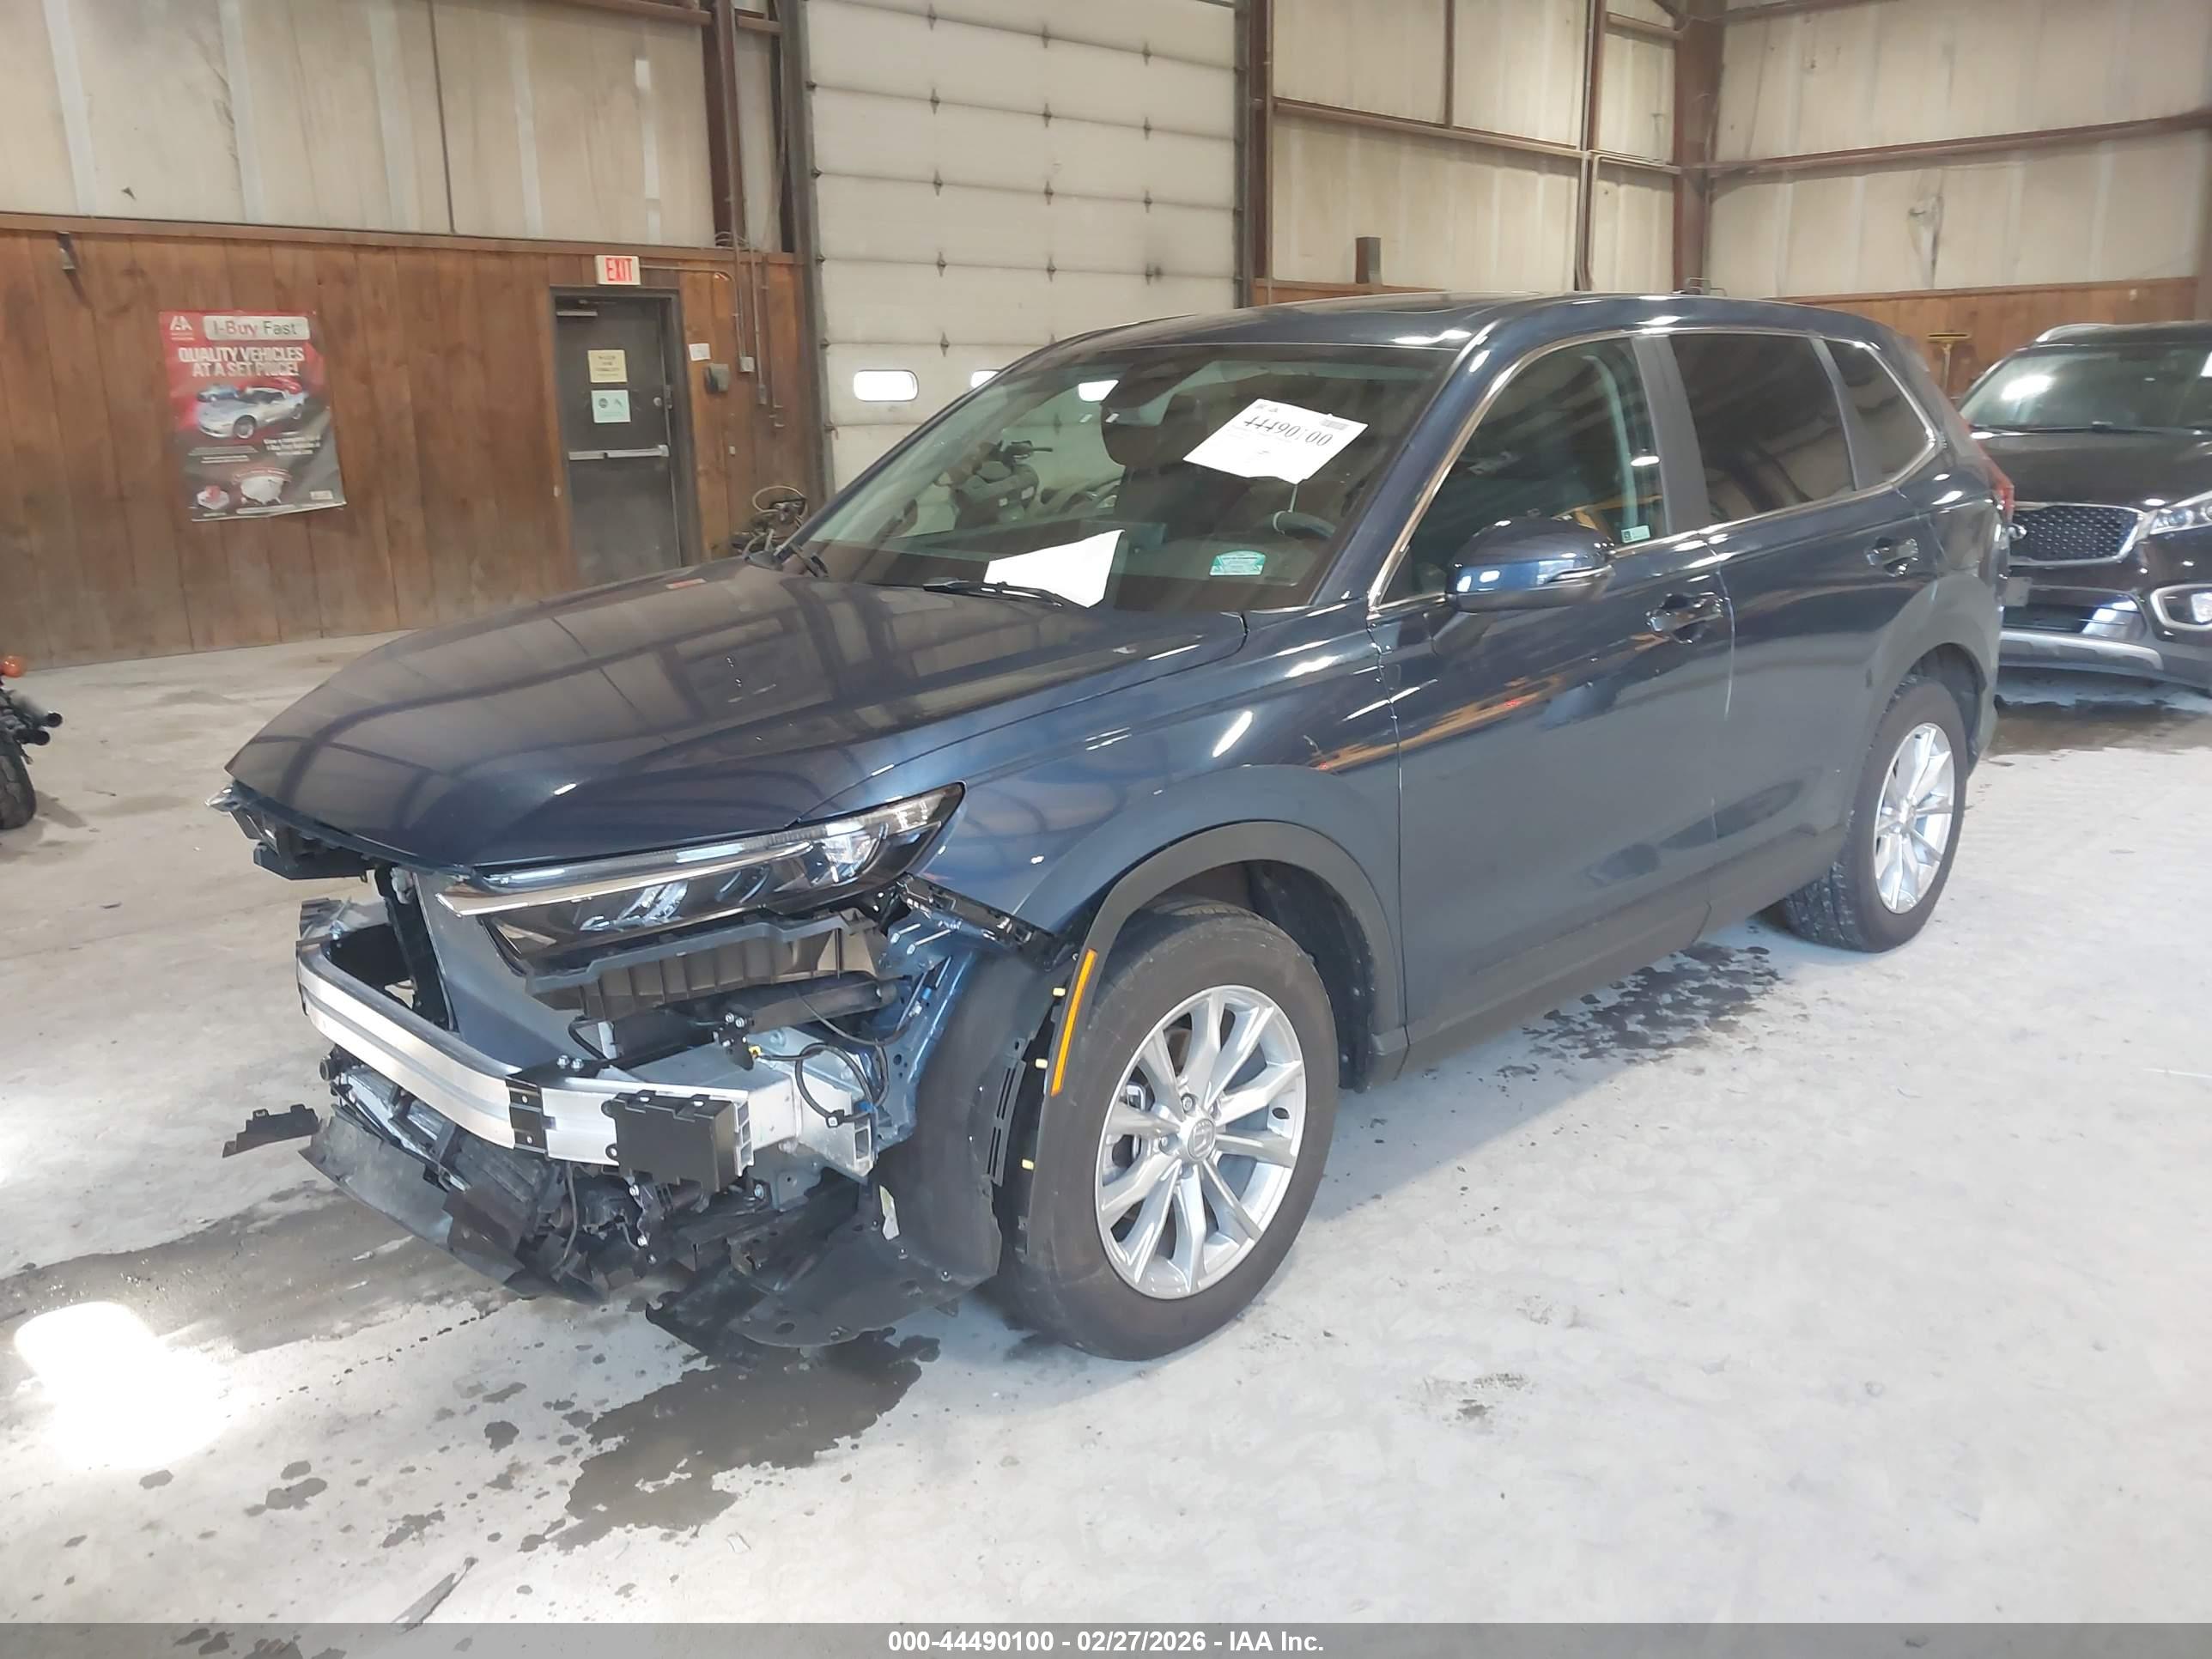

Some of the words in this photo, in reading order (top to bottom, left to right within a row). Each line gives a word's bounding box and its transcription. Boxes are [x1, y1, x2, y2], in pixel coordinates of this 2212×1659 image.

[605, 257, 633, 282] EXIT
[212, 320, 258, 336] I-Buy
[263, 320, 297, 335] Fast
[178, 347, 239, 363] QUALITY
[238, 347, 305, 362] VEHICLES
[191, 362, 212, 377] AT
[213, 362, 227, 377] A
[226, 362, 252, 377] SET
